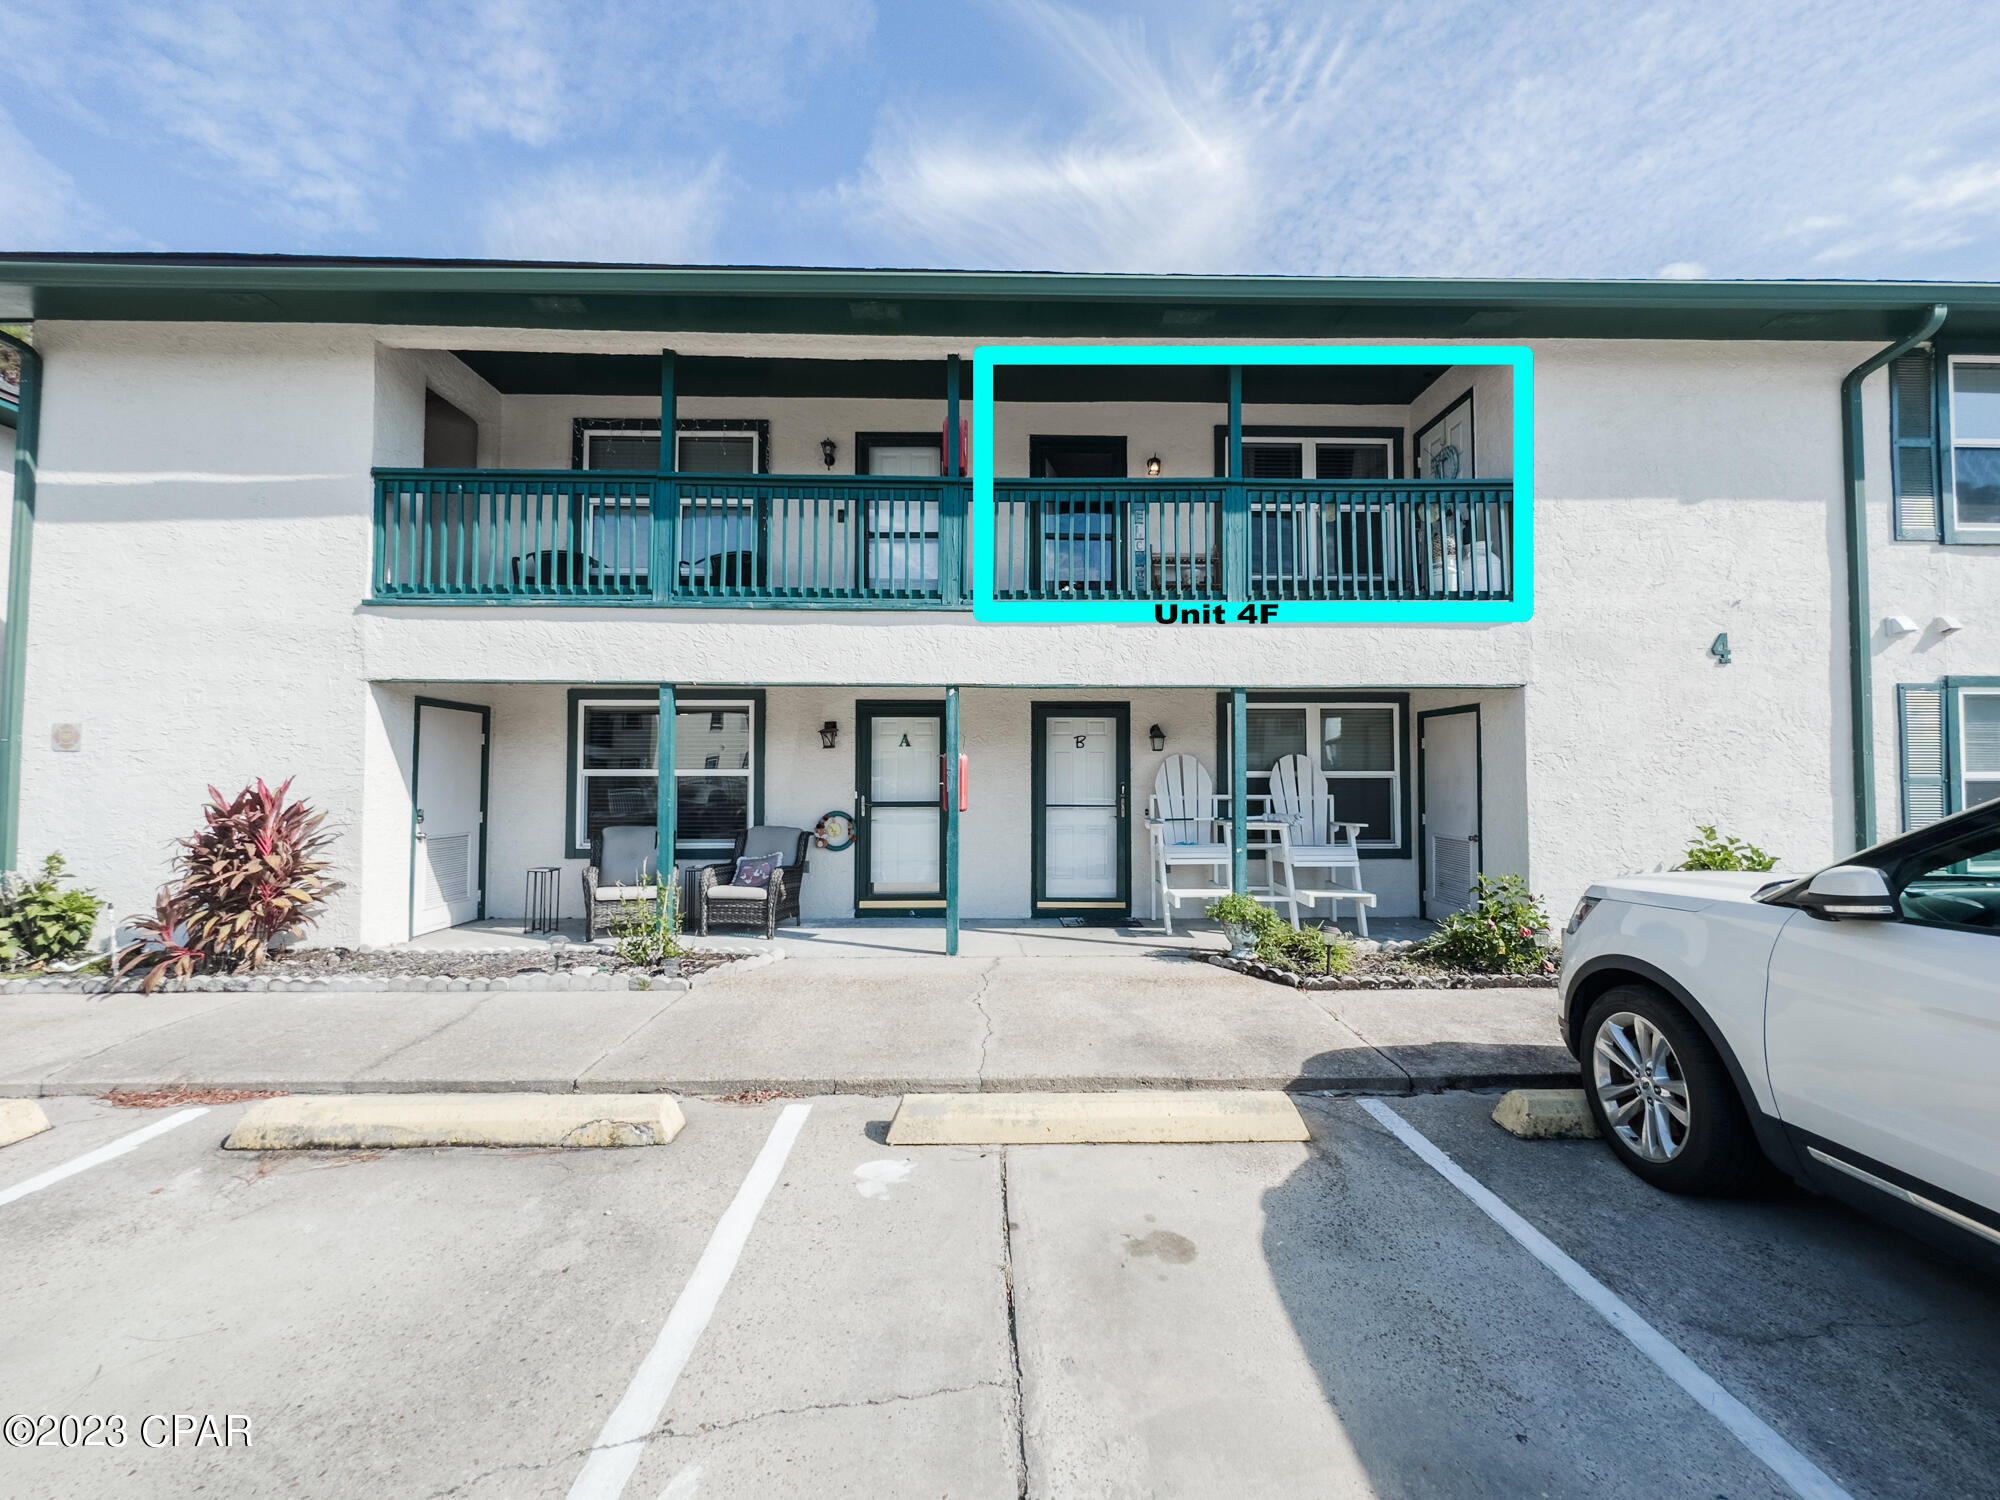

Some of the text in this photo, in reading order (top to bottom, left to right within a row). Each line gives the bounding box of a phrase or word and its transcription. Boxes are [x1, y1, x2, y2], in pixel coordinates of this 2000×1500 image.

[1710, 632, 1732, 664] 4
[898, 733, 912, 747] A
[1073, 735, 1087, 749] B
